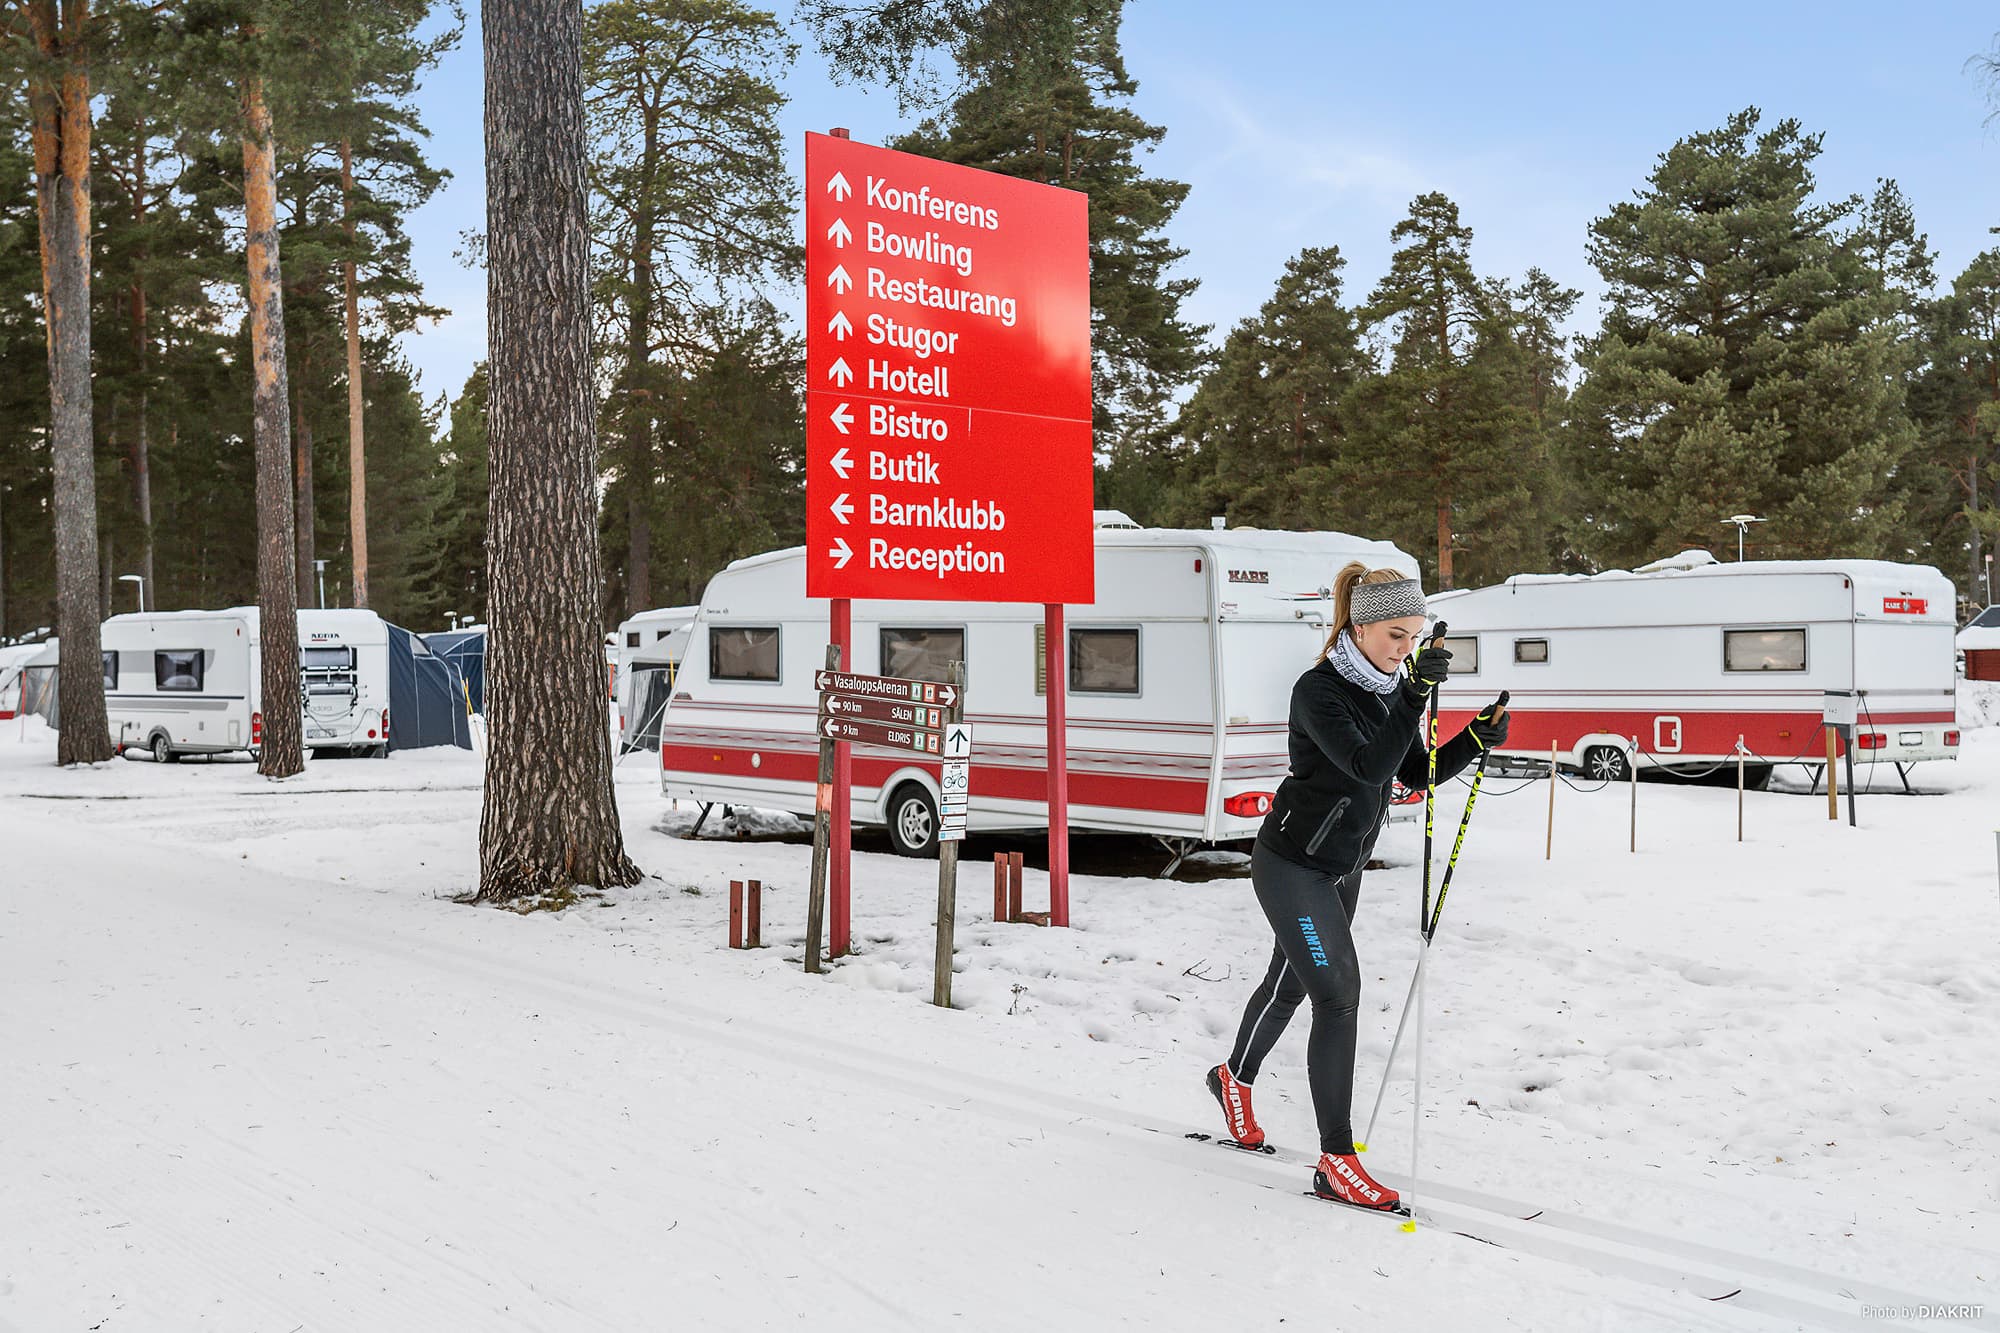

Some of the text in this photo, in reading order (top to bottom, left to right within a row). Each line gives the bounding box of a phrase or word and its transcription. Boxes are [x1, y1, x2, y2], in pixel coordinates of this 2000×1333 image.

[867, 175, 998, 231] Konferens
[868, 222, 972, 277] Bowling
[868, 268, 1016, 326] Restaurang
[867, 314, 958, 358] Stugor
[869, 359, 949, 398] Hotell
[869, 405, 948, 441] Bistro
[870, 452, 940, 484] Butik
[870, 494, 1005, 530] Barnklubb
[870, 538, 1005, 578] Reception
[834, 674, 908, 696] VasaloppsArenan
[842, 701, 913, 721] 90 km SÅLEN
[842, 725, 911, 745] 9 km ELDRIS
[1298, 916, 1328, 967] TRIMTEX
